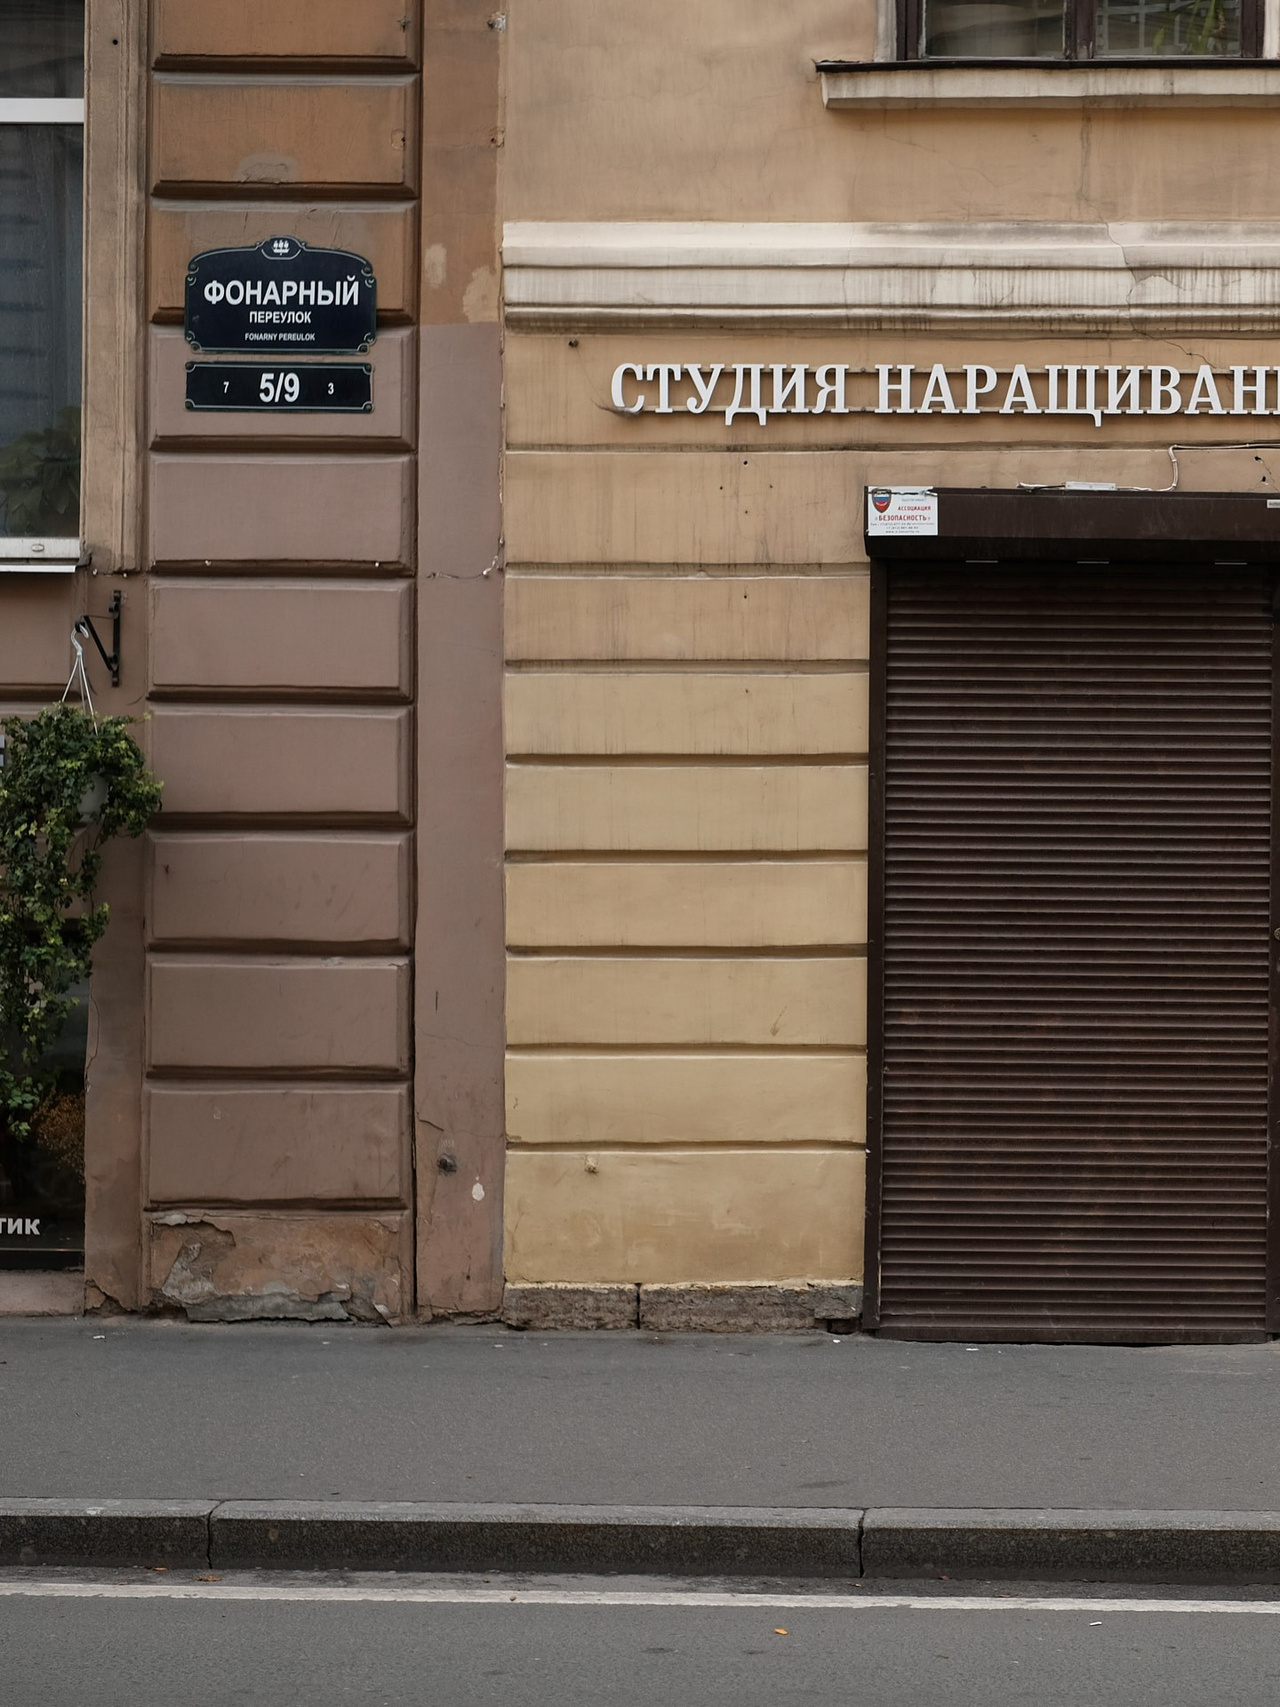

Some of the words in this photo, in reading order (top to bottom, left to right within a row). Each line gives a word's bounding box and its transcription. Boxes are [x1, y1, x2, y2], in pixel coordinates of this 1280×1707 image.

[203, 275, 360, 306] ФОНАРНЫЙ
[249, 311, 312, 324] ПЕРЕУЛОК
[244, 333, 278, 341] FONARNY
[278, 333, 316, 342] PEREULOK
[223, 381, 230, 394] 7
[259, 372, 300, 403] 5/9
[327, 382, 335, 395] 3
[611, 363, 850, 426] СТУДИЯ
